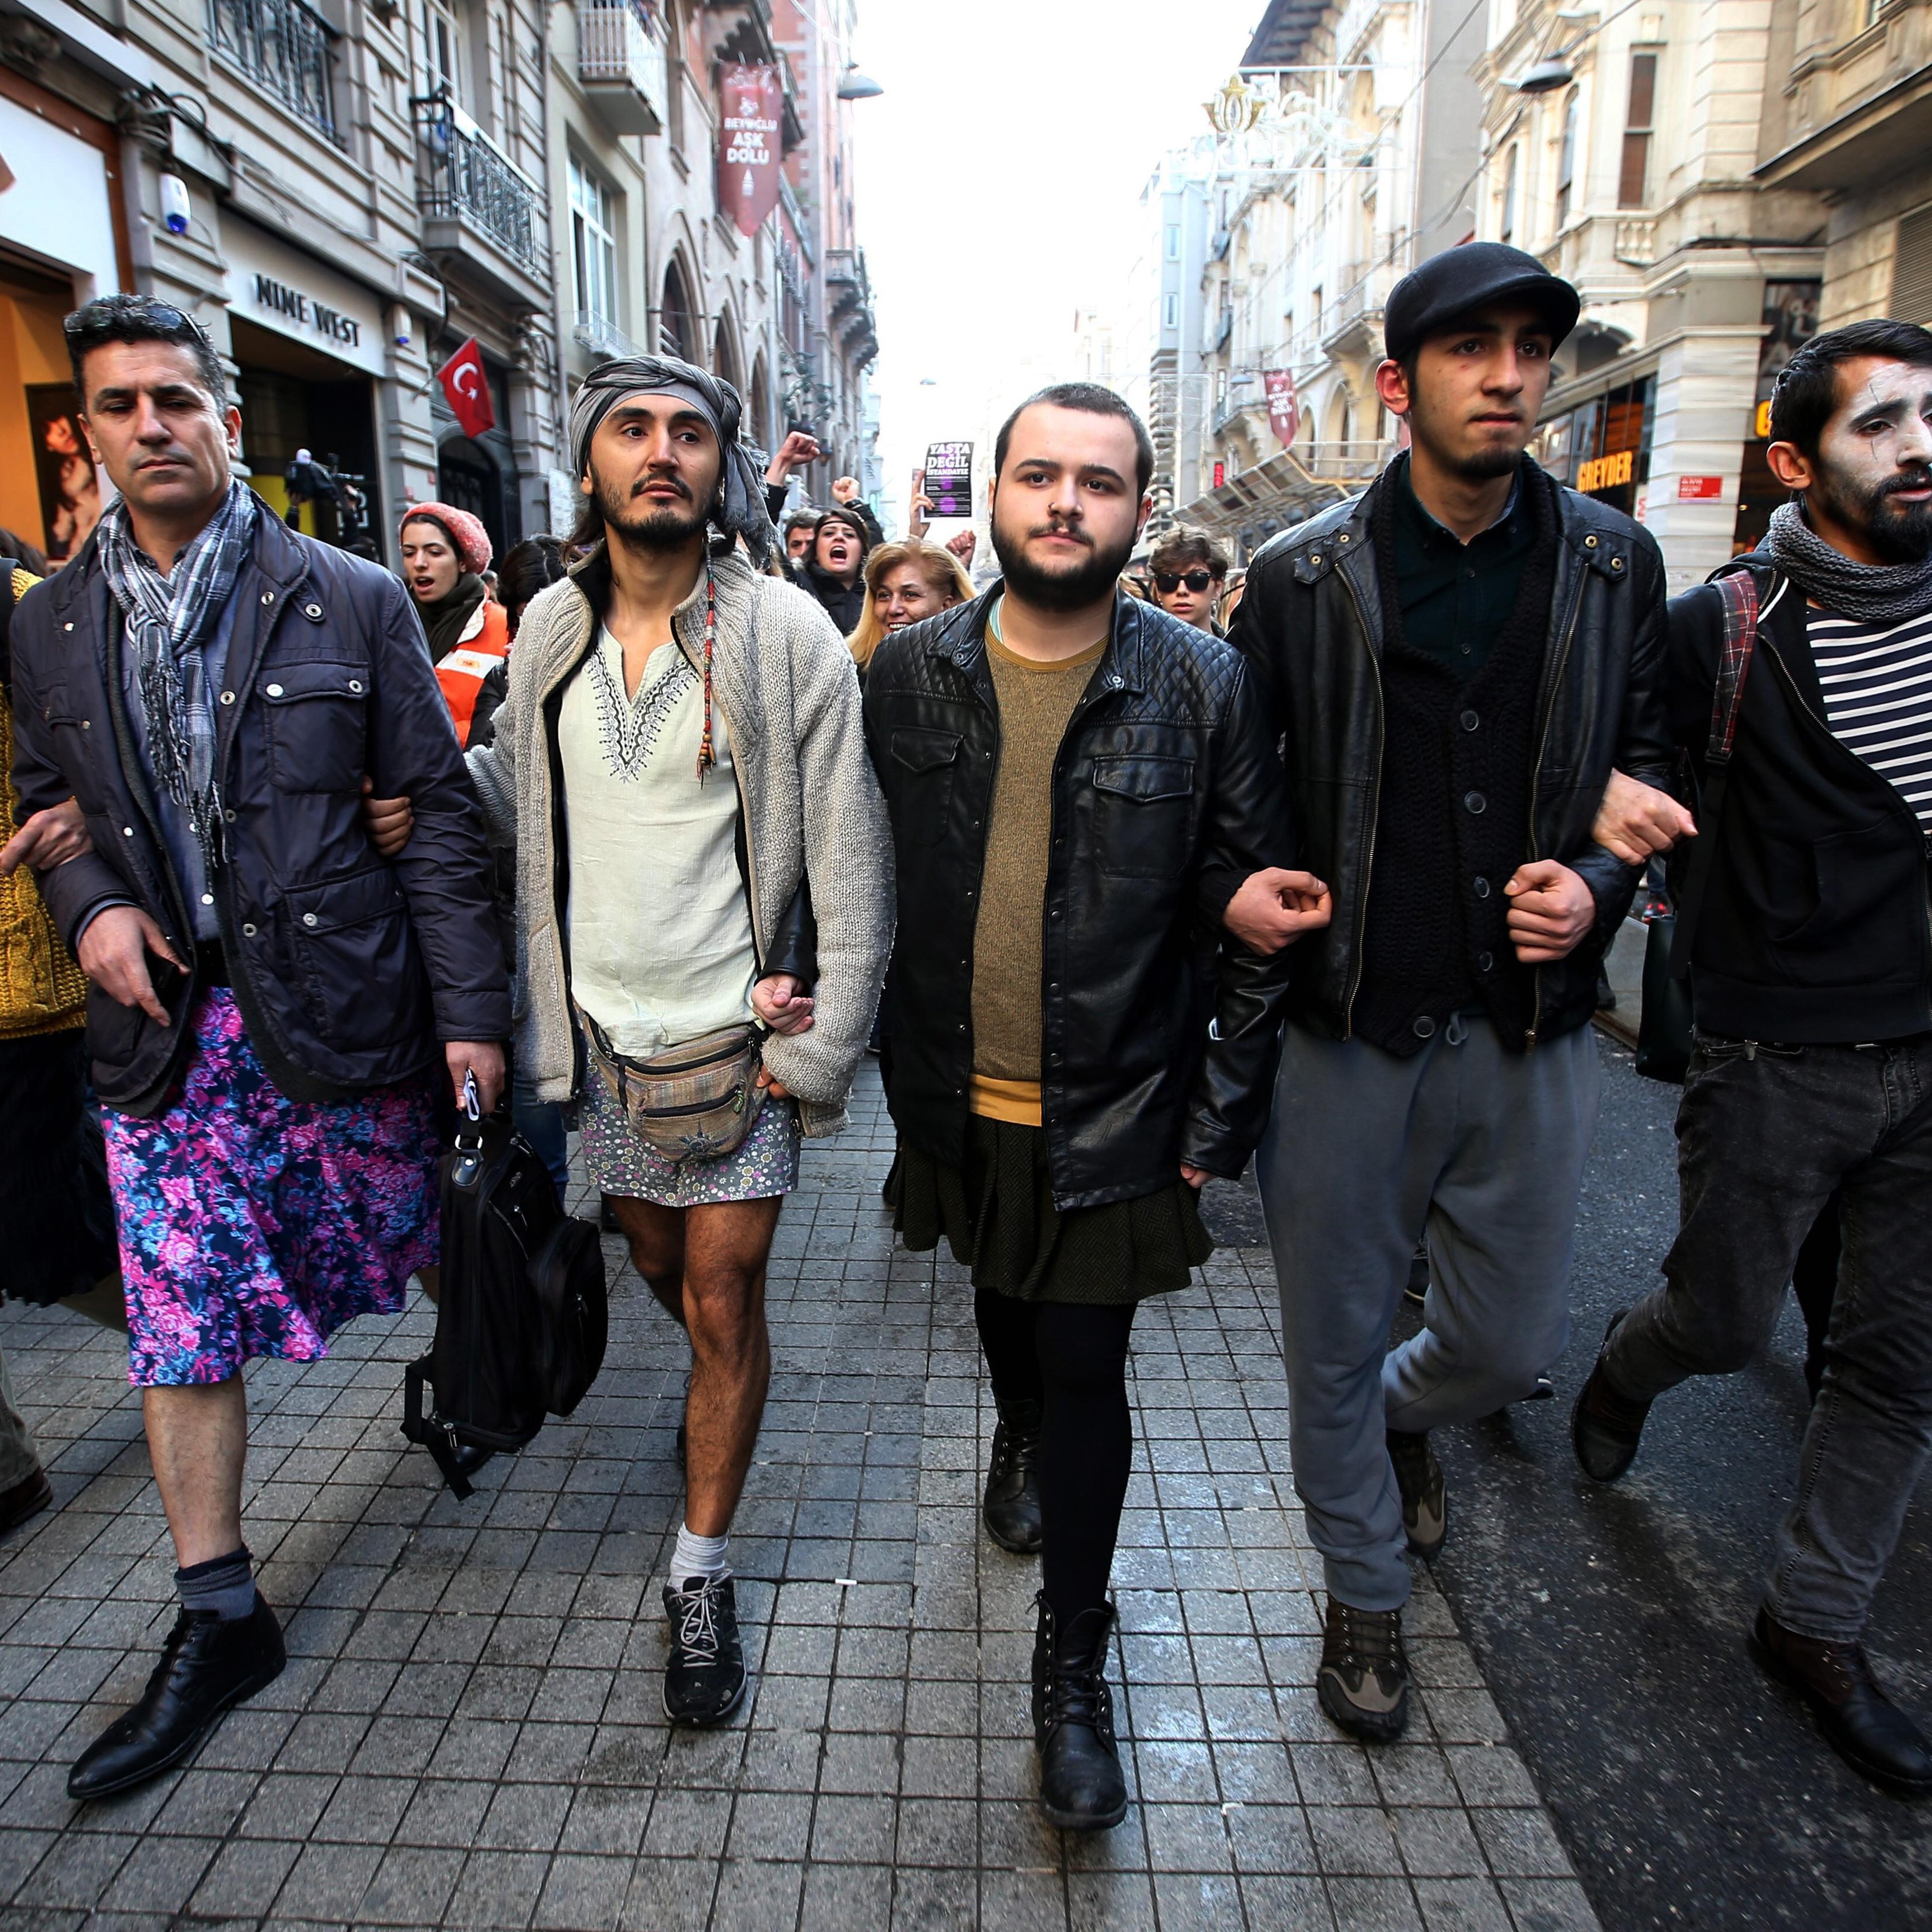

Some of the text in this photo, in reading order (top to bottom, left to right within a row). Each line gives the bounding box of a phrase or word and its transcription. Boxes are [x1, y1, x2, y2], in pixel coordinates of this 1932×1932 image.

[727, 147, 770, 165] DOLU
[255, 273, 360, 347] NINE WEST
[930, 443, 971, 454] YASTA
[927, 453, 969, 468] DEĞİL
[1577, 451, 1632, 493] GREYDER
